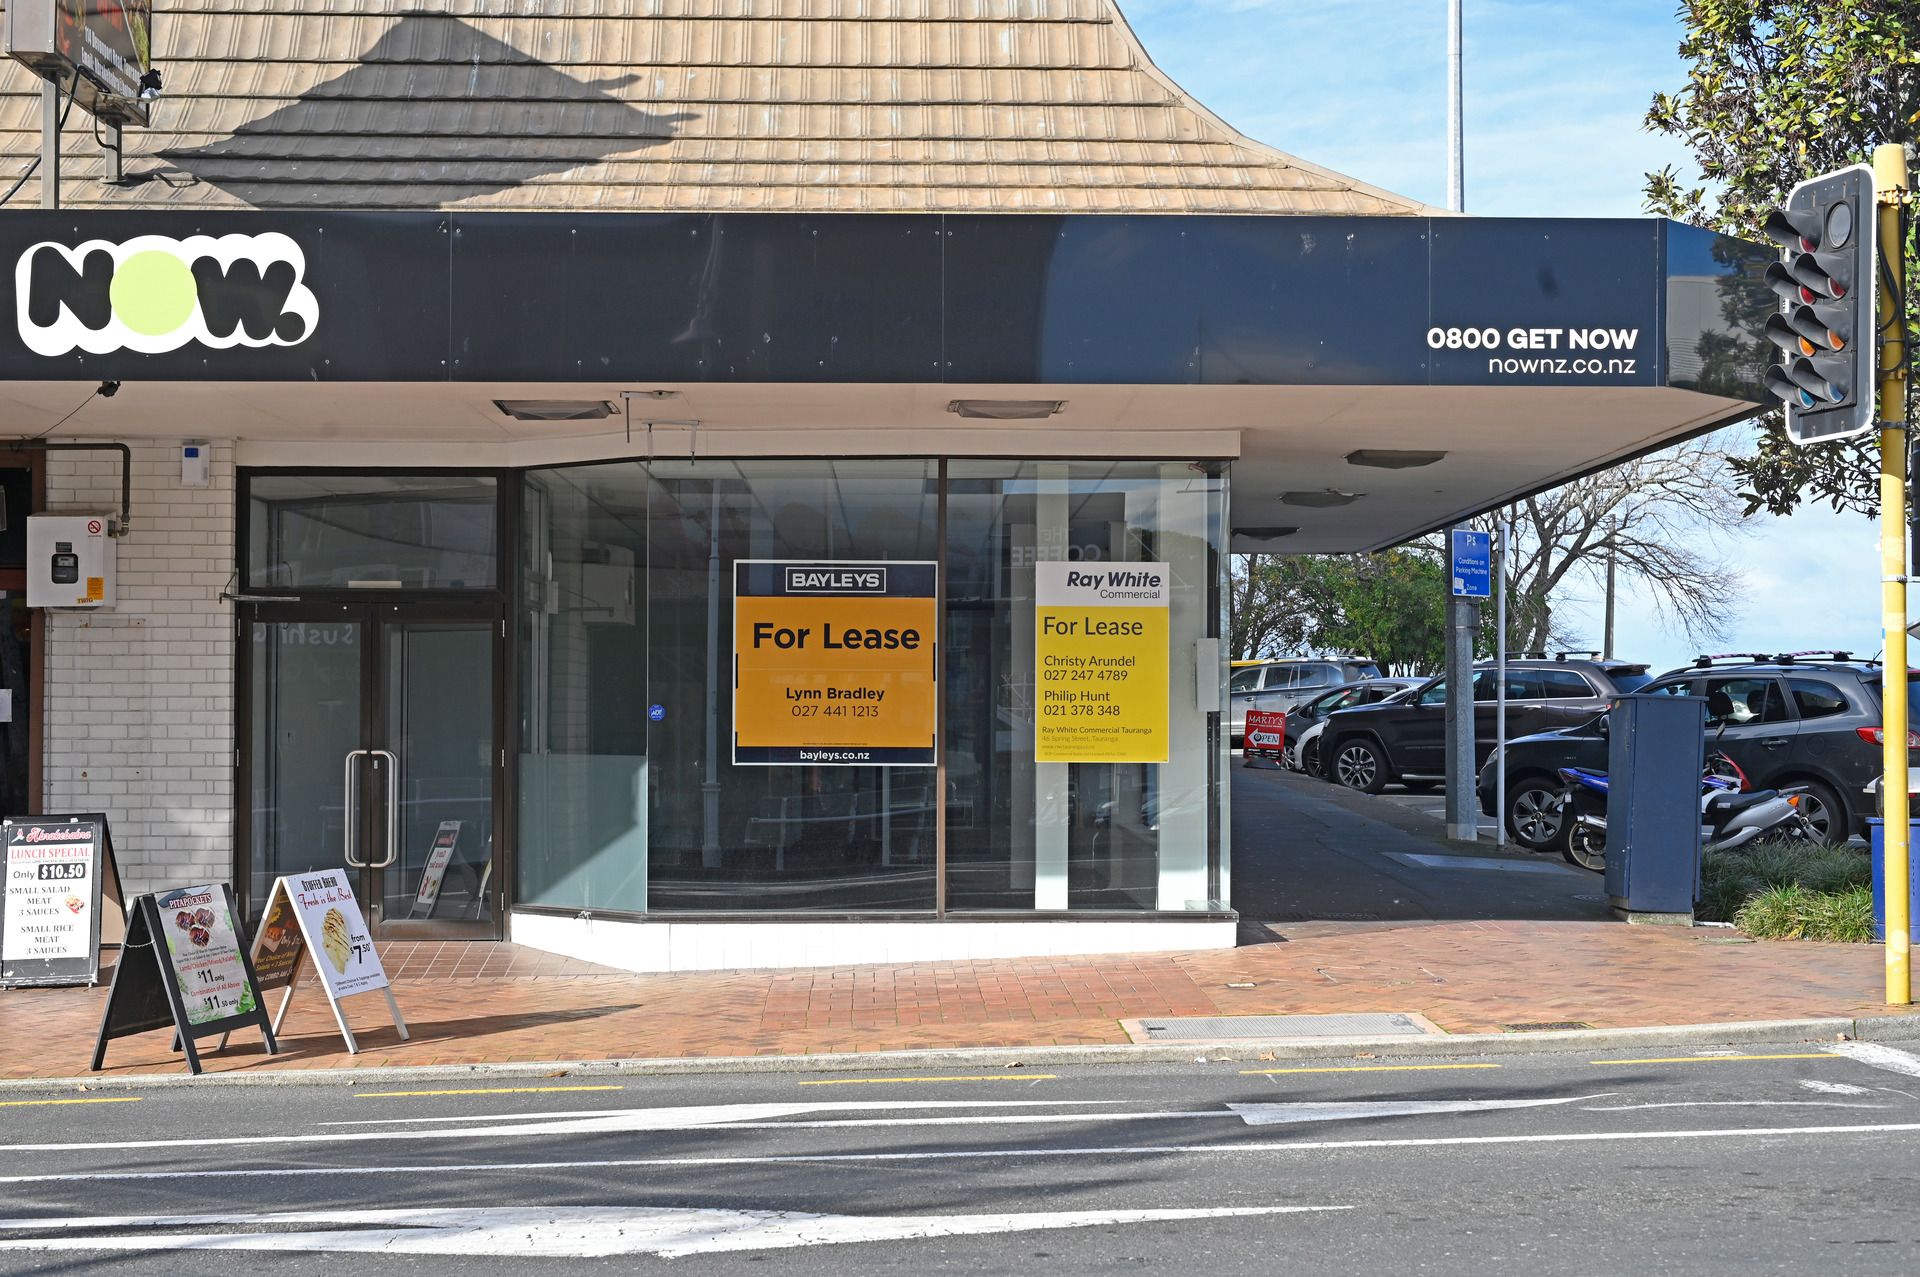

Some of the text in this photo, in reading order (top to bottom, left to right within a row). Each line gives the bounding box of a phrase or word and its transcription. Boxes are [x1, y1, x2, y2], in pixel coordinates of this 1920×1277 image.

[1427, 327, 1638, 350] 0800 GET NOW
[1488, 358, 1636, 374] nownz.co.nz
[1456, 567, 1471, 575] Parking
[792, 573, 880, 587] BAYLEYS
[1067, 571, 1161, 590] Ray White
[1100, 589, 1160, 599] Commercial
[1044, 617, 1143, 635] For Lease
[754, 622, 920, 649] For Lease
[1044, 655, 1136, 668] Christy Arundel
[1044, 670, 1128, 680] 027 247 4789
[786, 687, 885, 701] Lynn Bradley
[1044, 690, 1110, 703] Philip Hunt
[792, 705, 879, 717] 027 441 1213
[1044, 705, 1120, 716] 021 378 348
[1042, 726, 1152, 735] Ray White Commercial Tauranga
[800, 751, 870, 760] bayleys.co.nz
[26, 827, 91, 842] Abrakebabra
[11, 848, 90, 859] LUNCH SPECIAL
[13, 864, 84, 880] Only $10.50
[9, 887, 39, 895] SMALL
[326, 890, 337, 903] the
[27, 897, 52, 905] MEAT
[26, 908, 60, 916] SAUCES
[21, 924, 74, 933] SMALL RICE
[351, 934, 365, 943] from
[26, 946, 67, 955] 3 SAUCES
[191, 987, 216, 997] Combination
[227, 981, 240, 989] Above
[229, 998, 239, 1006] only
